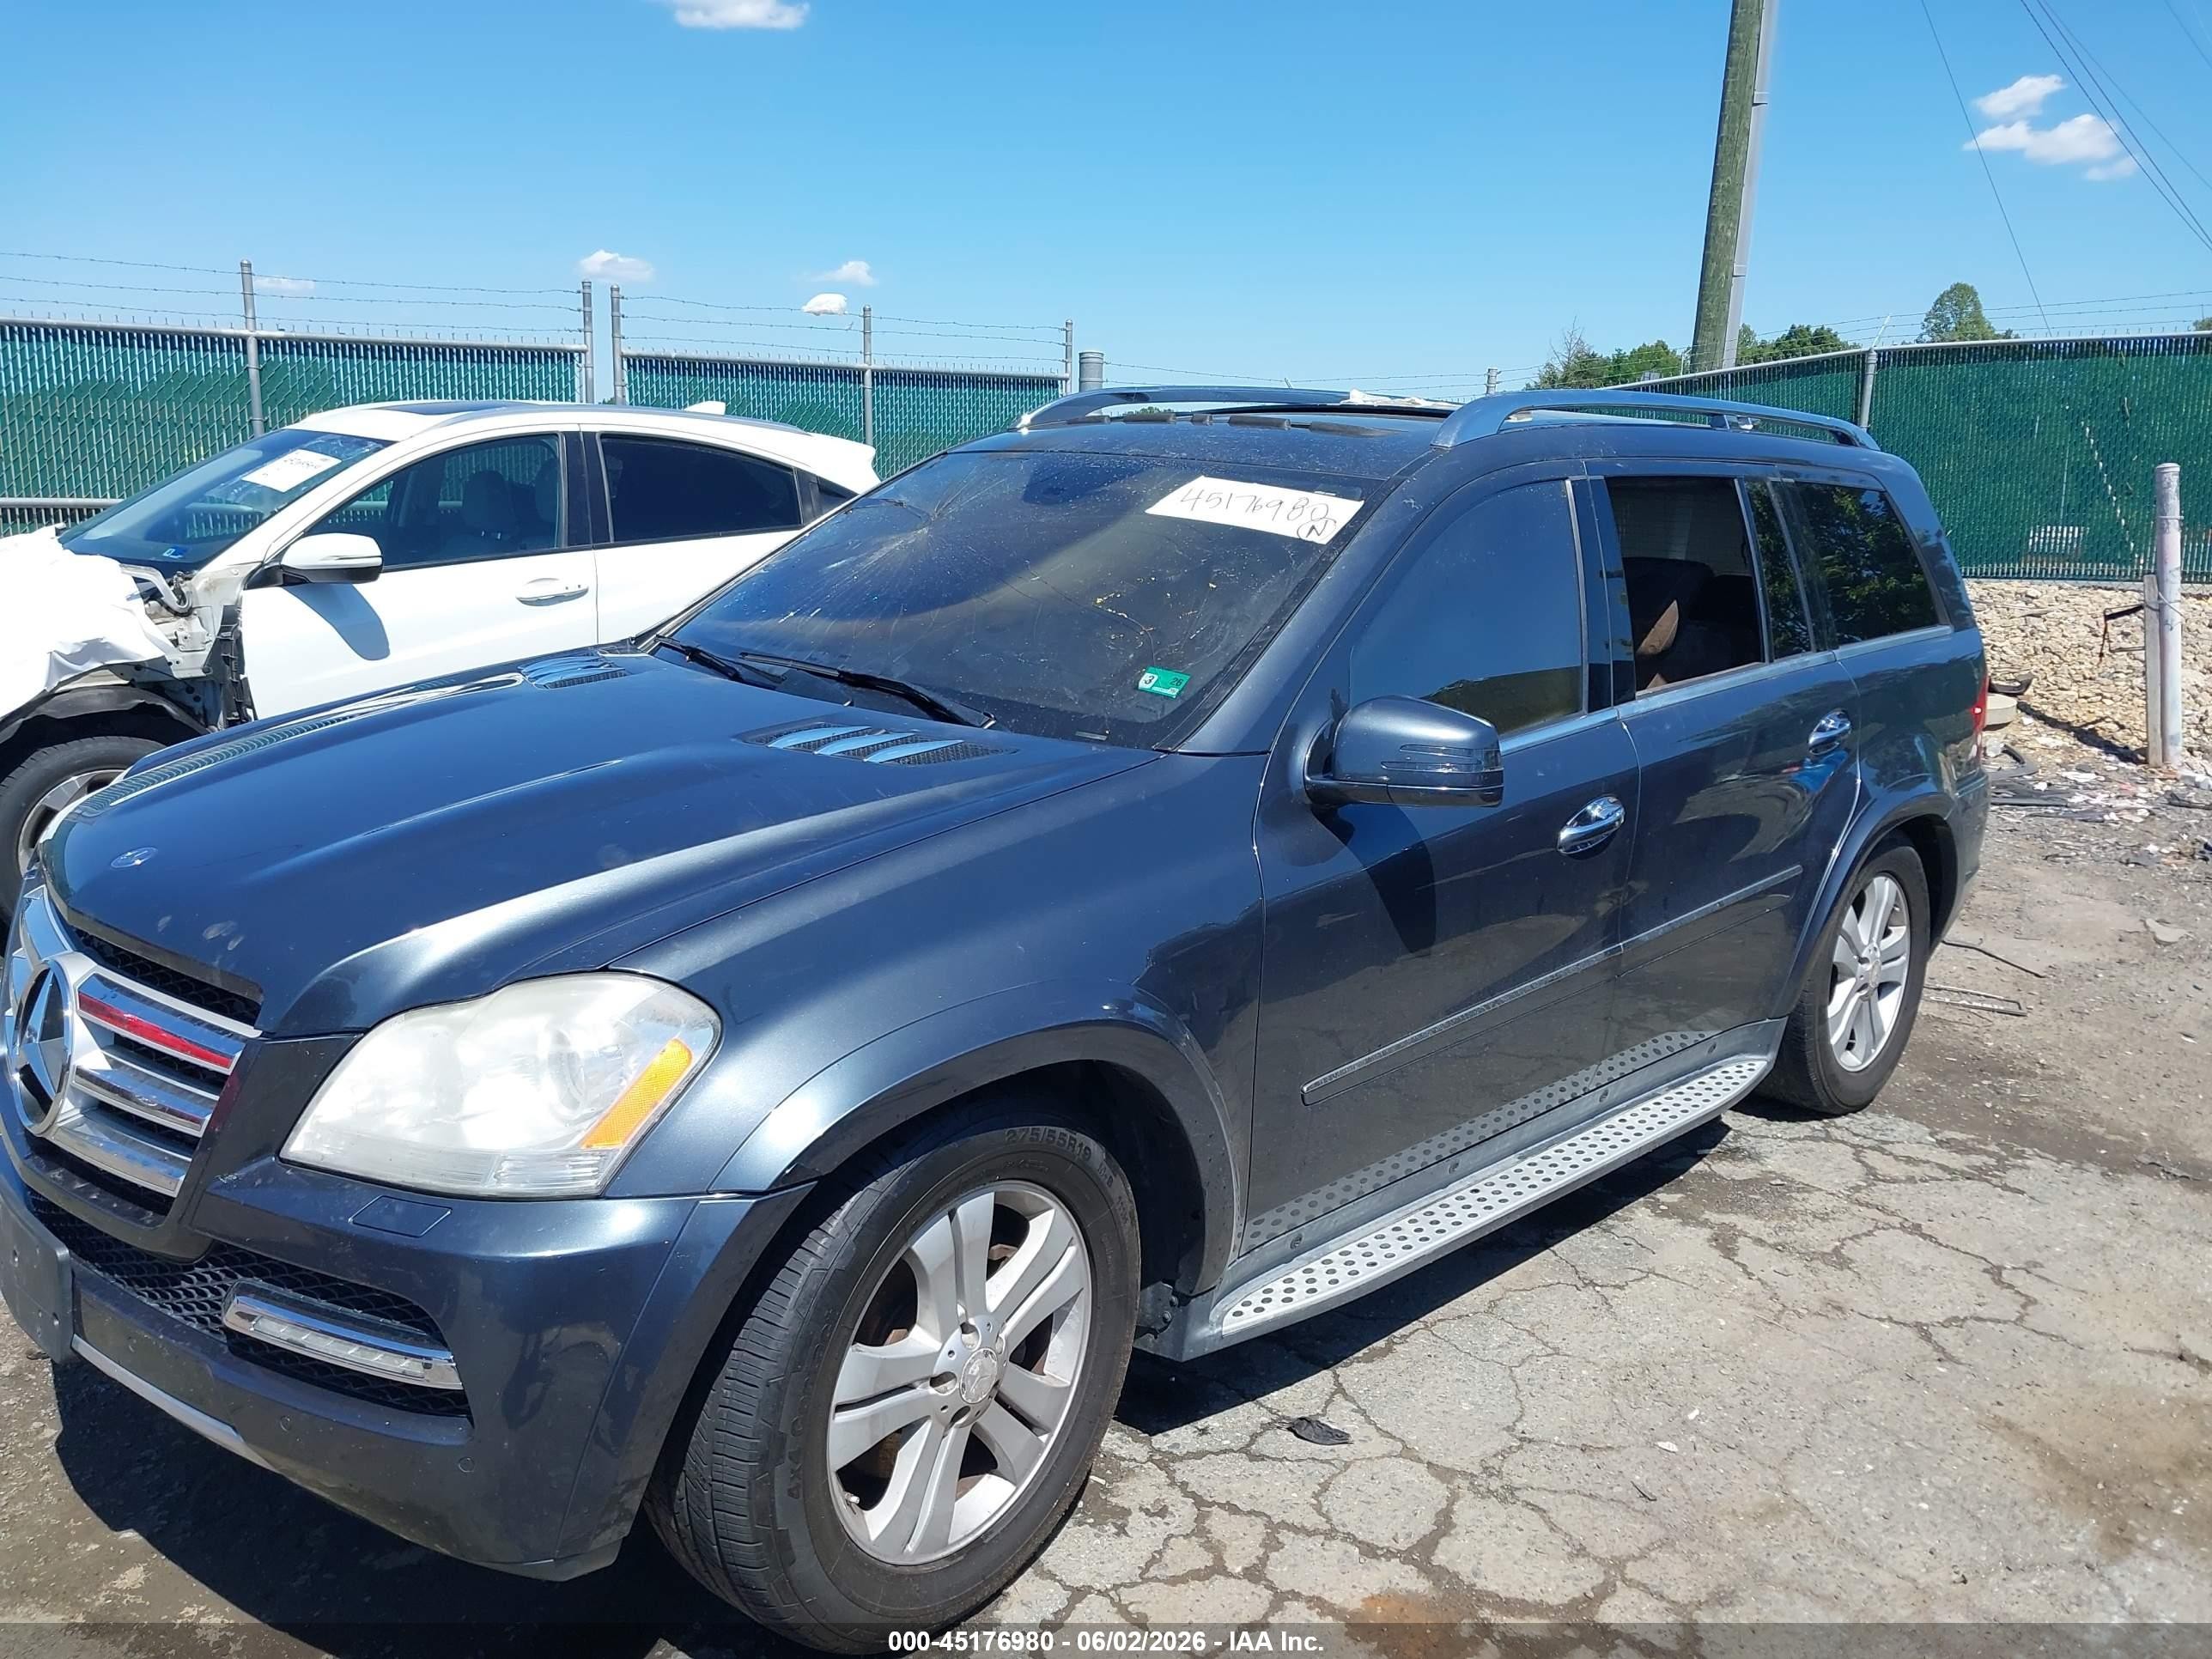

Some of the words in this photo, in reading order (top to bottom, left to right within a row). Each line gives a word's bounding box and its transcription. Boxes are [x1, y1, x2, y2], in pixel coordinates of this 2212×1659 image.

[1181, 488, 1329, 521] 45176980
[1142, 675, 1155, 685] 3
[1170, 677, 1184, 687] 26
[1006, 1127, 1092, 1161] 275/55R19
